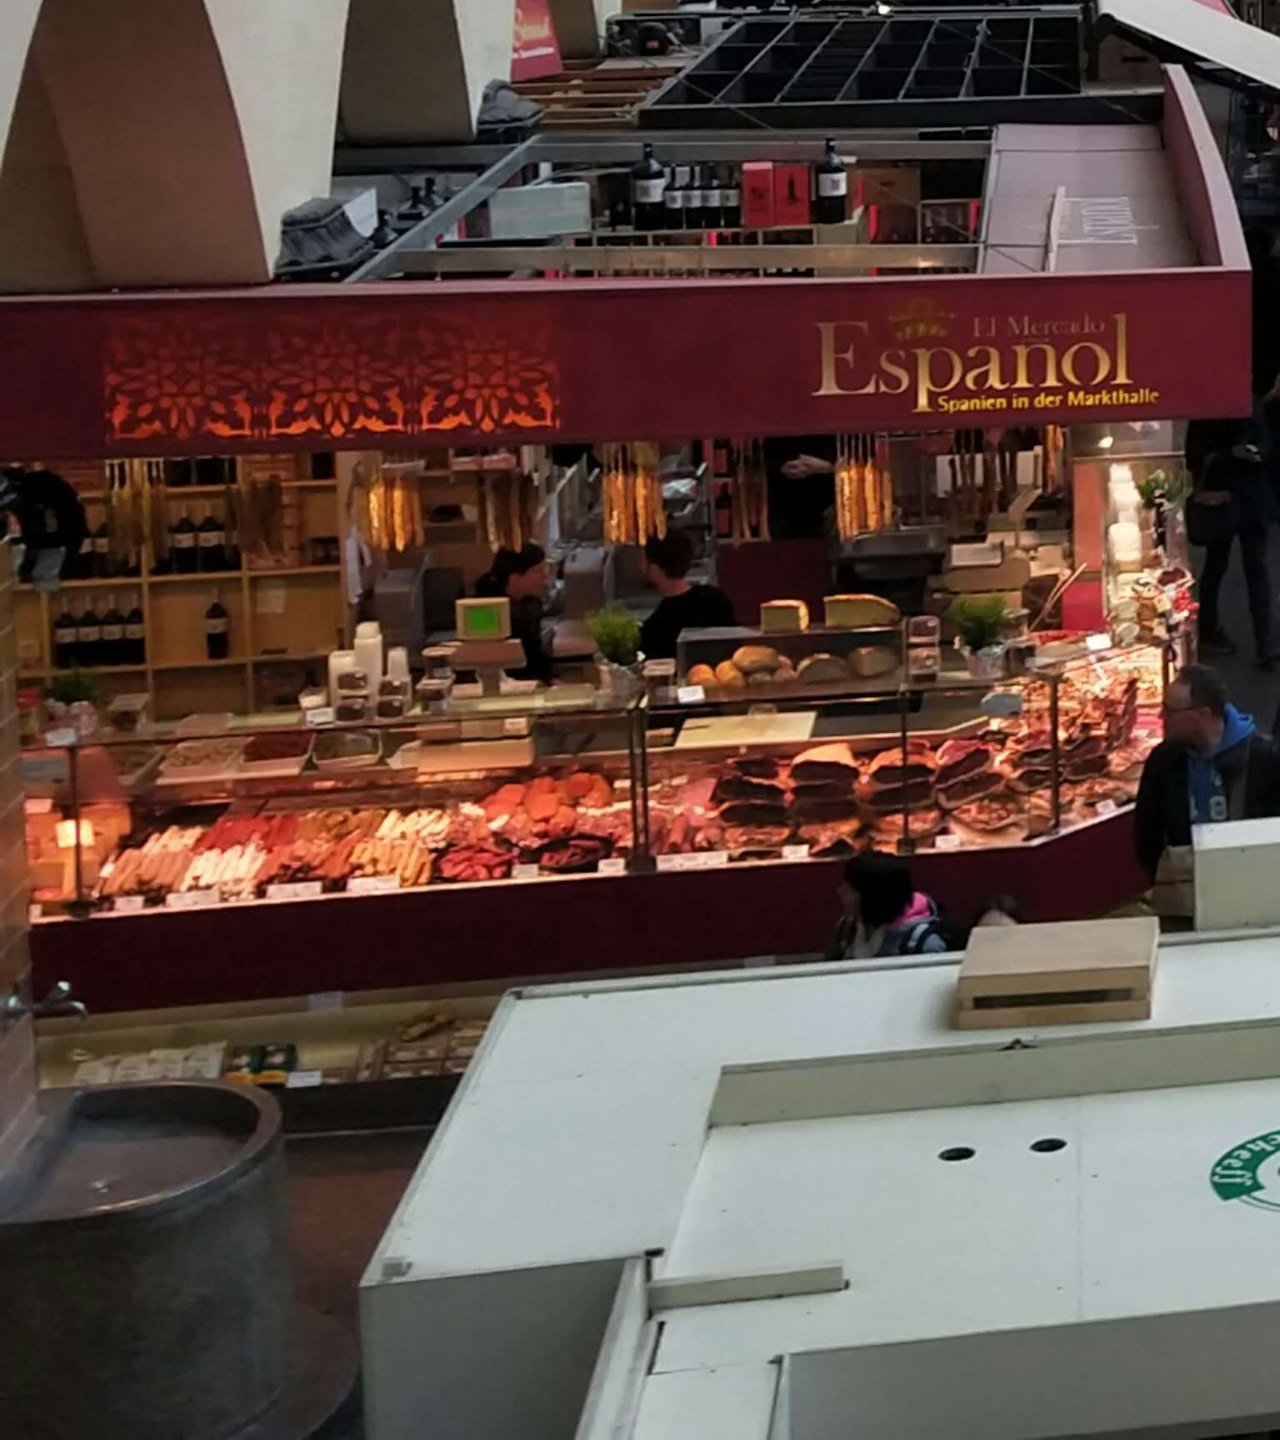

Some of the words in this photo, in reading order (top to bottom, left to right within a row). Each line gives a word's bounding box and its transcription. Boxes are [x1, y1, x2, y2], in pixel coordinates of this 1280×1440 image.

[973, 317, 997, 338] El
[1008, 313, 1106, 338] Mercado
[812, 313, 1134, 414] Español
[937, 394, 1007, 415] Spanien
[1012, 393, 1029, 409] in
[1034, 392, 1062, 409] der
[1067, 388, 1160, 407] Markthalle
